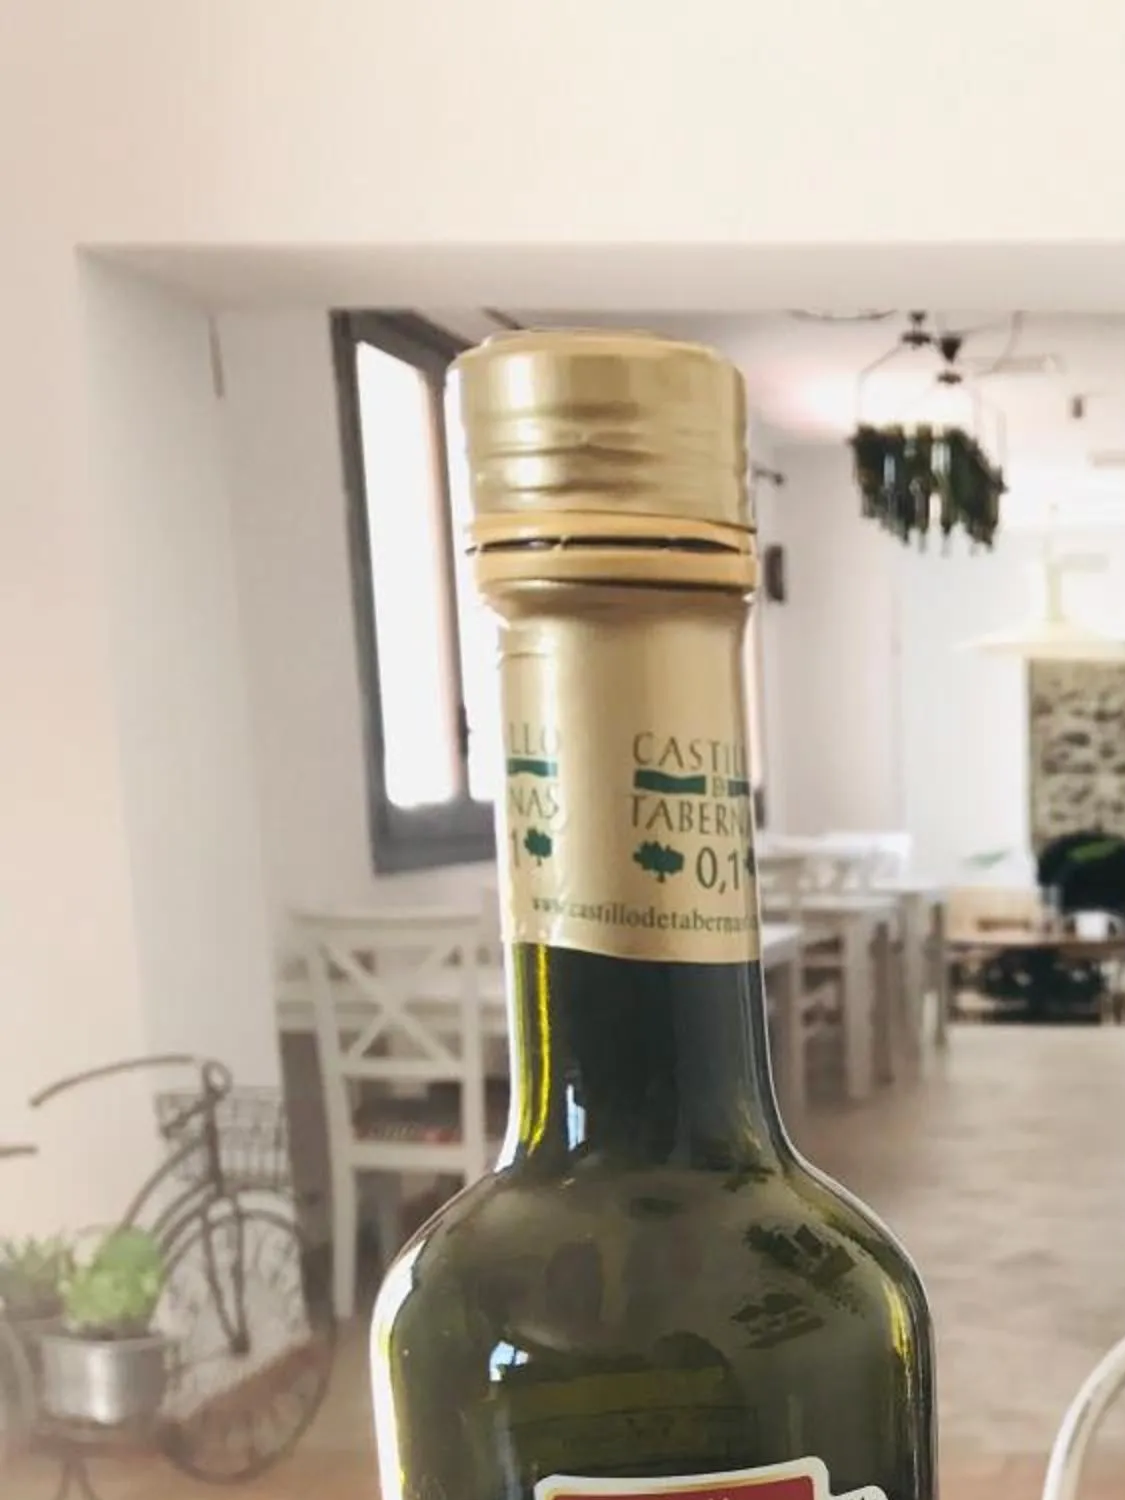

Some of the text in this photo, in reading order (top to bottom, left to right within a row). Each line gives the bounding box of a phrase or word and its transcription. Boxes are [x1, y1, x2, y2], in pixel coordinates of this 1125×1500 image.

[633, 731, 746, 778] CASTILL
[630, 795, 747, 838] TABERN
[695, 847, 741, 895] 0,1
